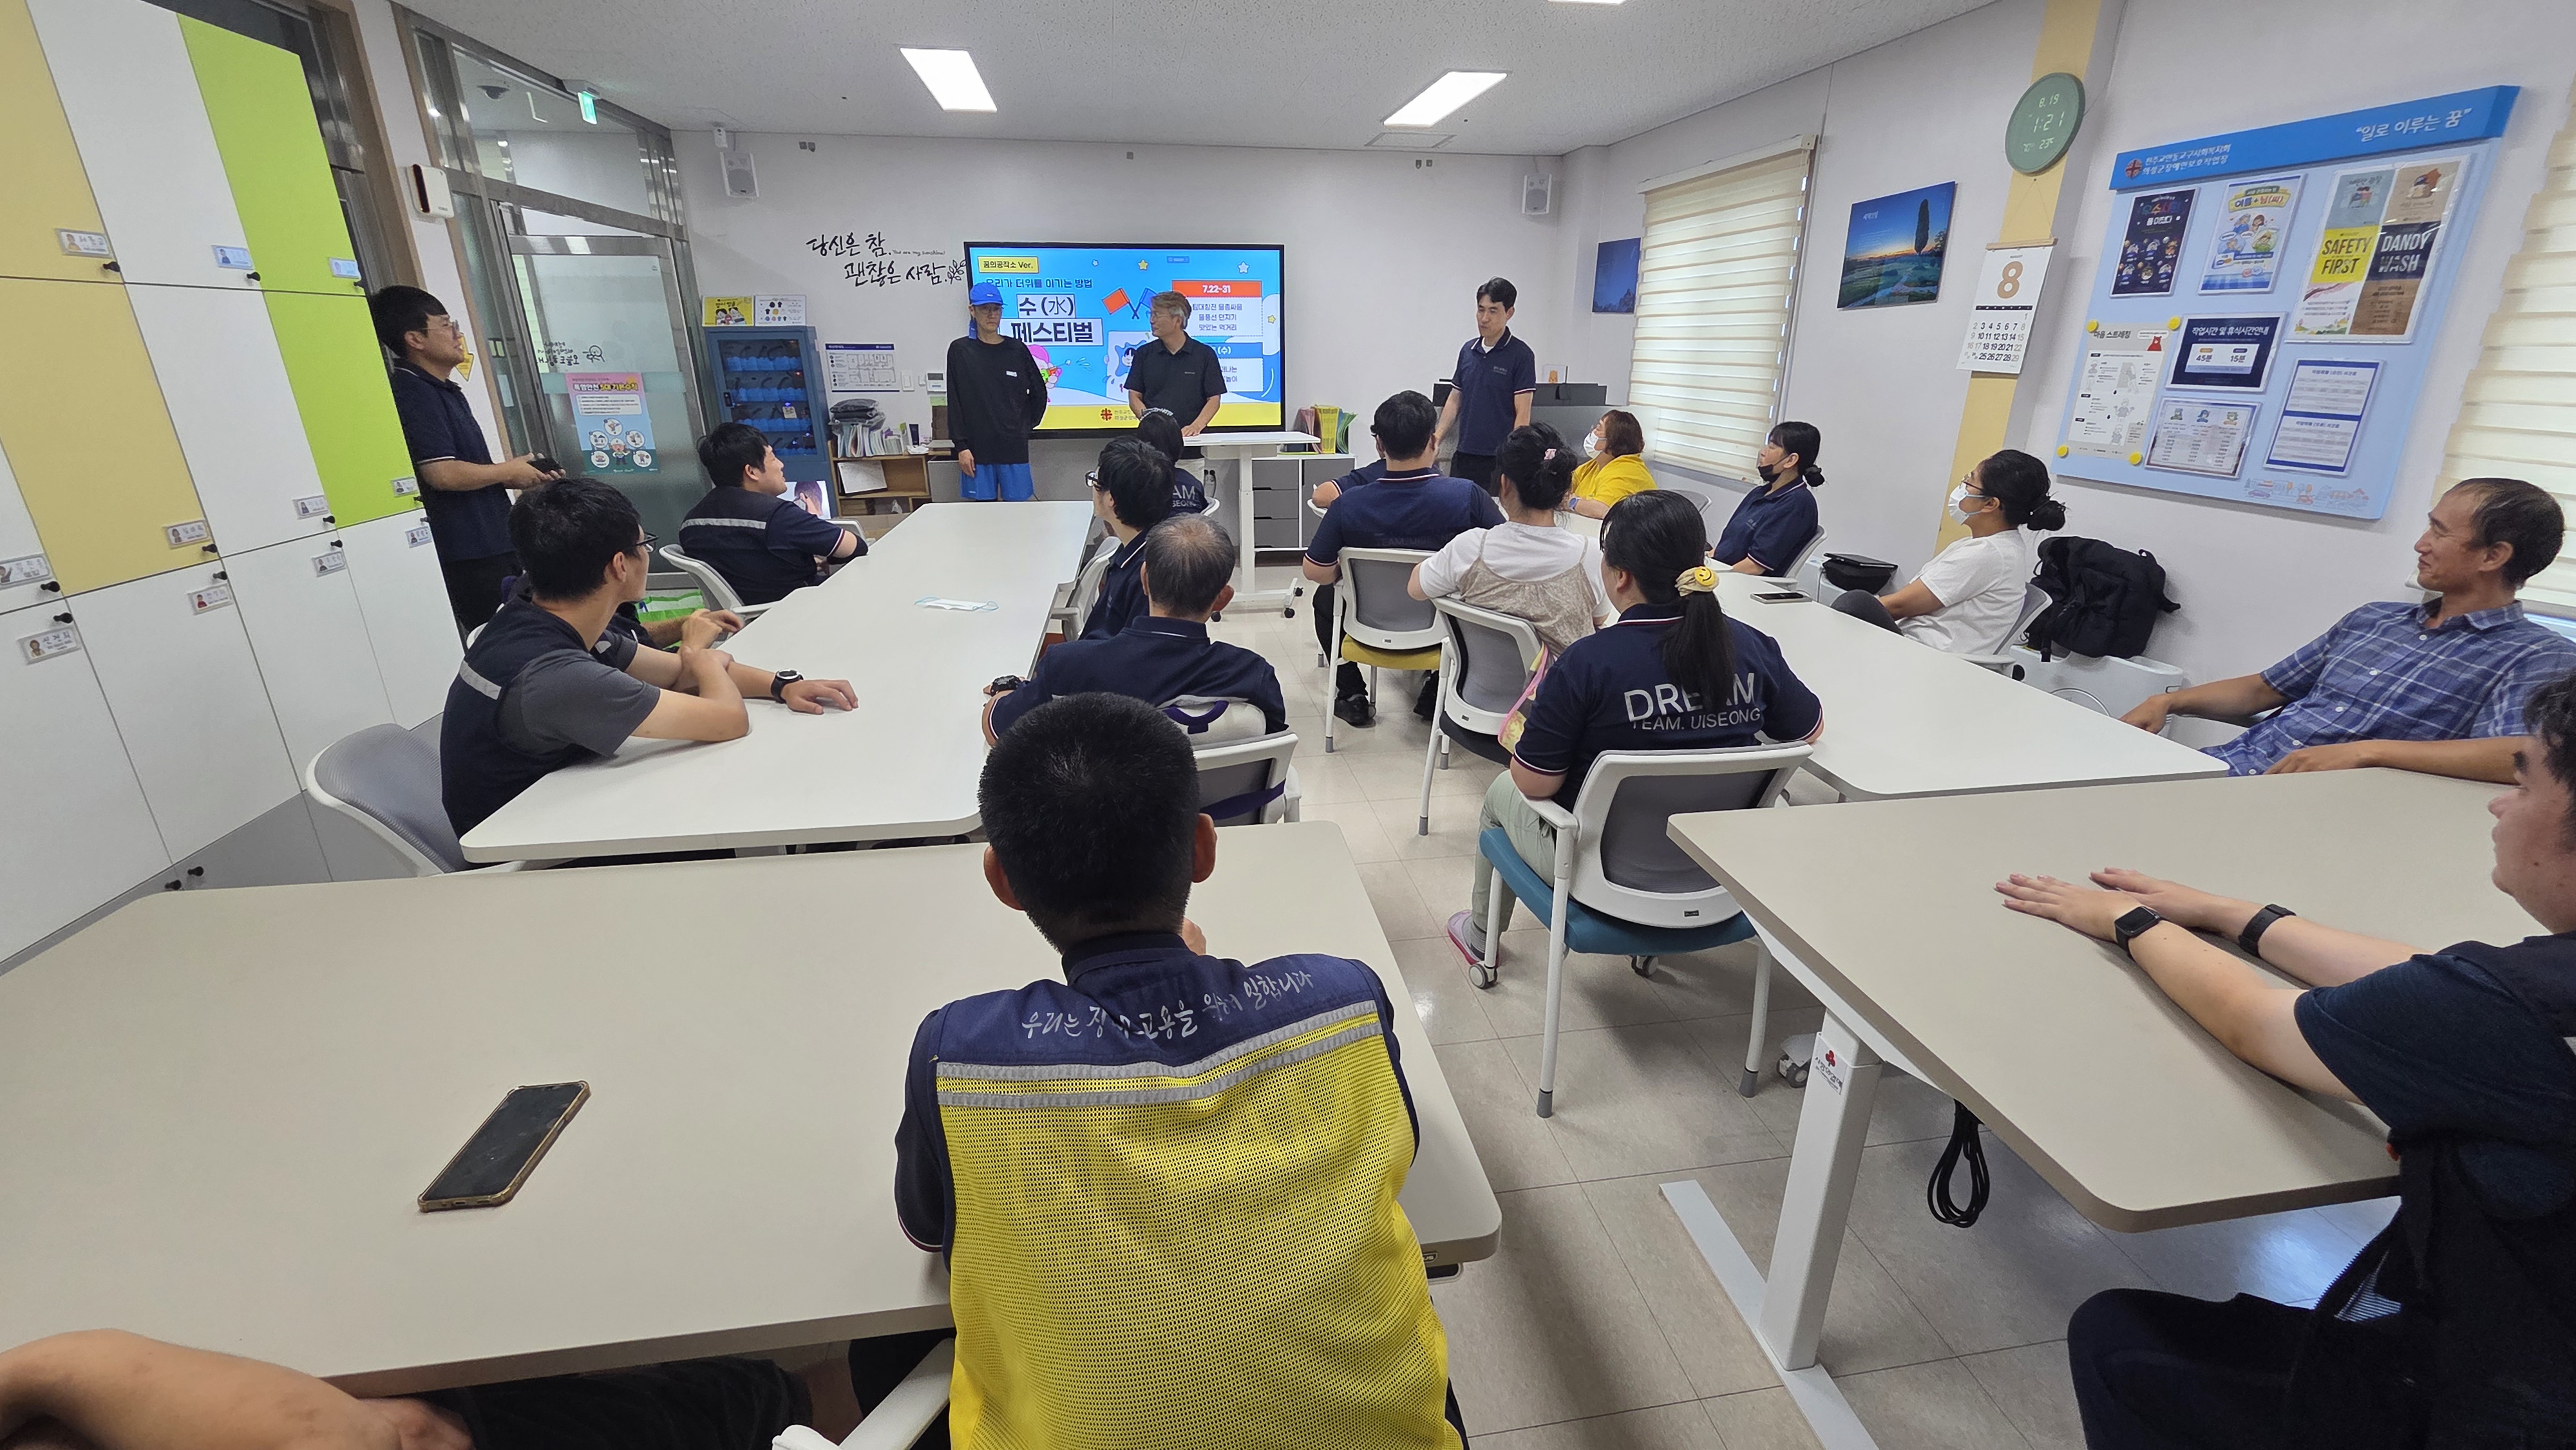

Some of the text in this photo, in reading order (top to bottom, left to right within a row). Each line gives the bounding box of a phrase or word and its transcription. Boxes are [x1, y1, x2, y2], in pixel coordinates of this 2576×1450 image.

[2033, 111, 2065, 133] 1:21
[2394, 115, 2441, 135] 이루는
[806, 232, 860, 257] 당신은
[2322, 236, 2373, 256] SAFETY
[2380, 232, 2431, 252] DANDY
[2321, 258, 2360, 274] FIRST
[2378, 254, 2421, 272] WASH
[844, 260, 901, 287] 괜찮은
[1016, 279, 1042, 288] 더위를
[1046, 279, 1072, 288] 이기는
[1075, 279, 1093, 288] 방법
[1997, 261, 2023, 299] 8
[1019, 297, 1036, 315] 수
[1011, 322, 1094, 343] 페스티벌
[2106, 330, 2131, 339] 스트레칭
[2192, 326, 2218, 335] 작업시간
[2219, 326, 2226, 335] 및
[1624, 672, 1755, 722] DREM
[1691, 708, 1761, 729] UISEONG
[1021, 1012, 1082, 1039] 우리는
[1244, 970, 1314, 1011] 일합니다
